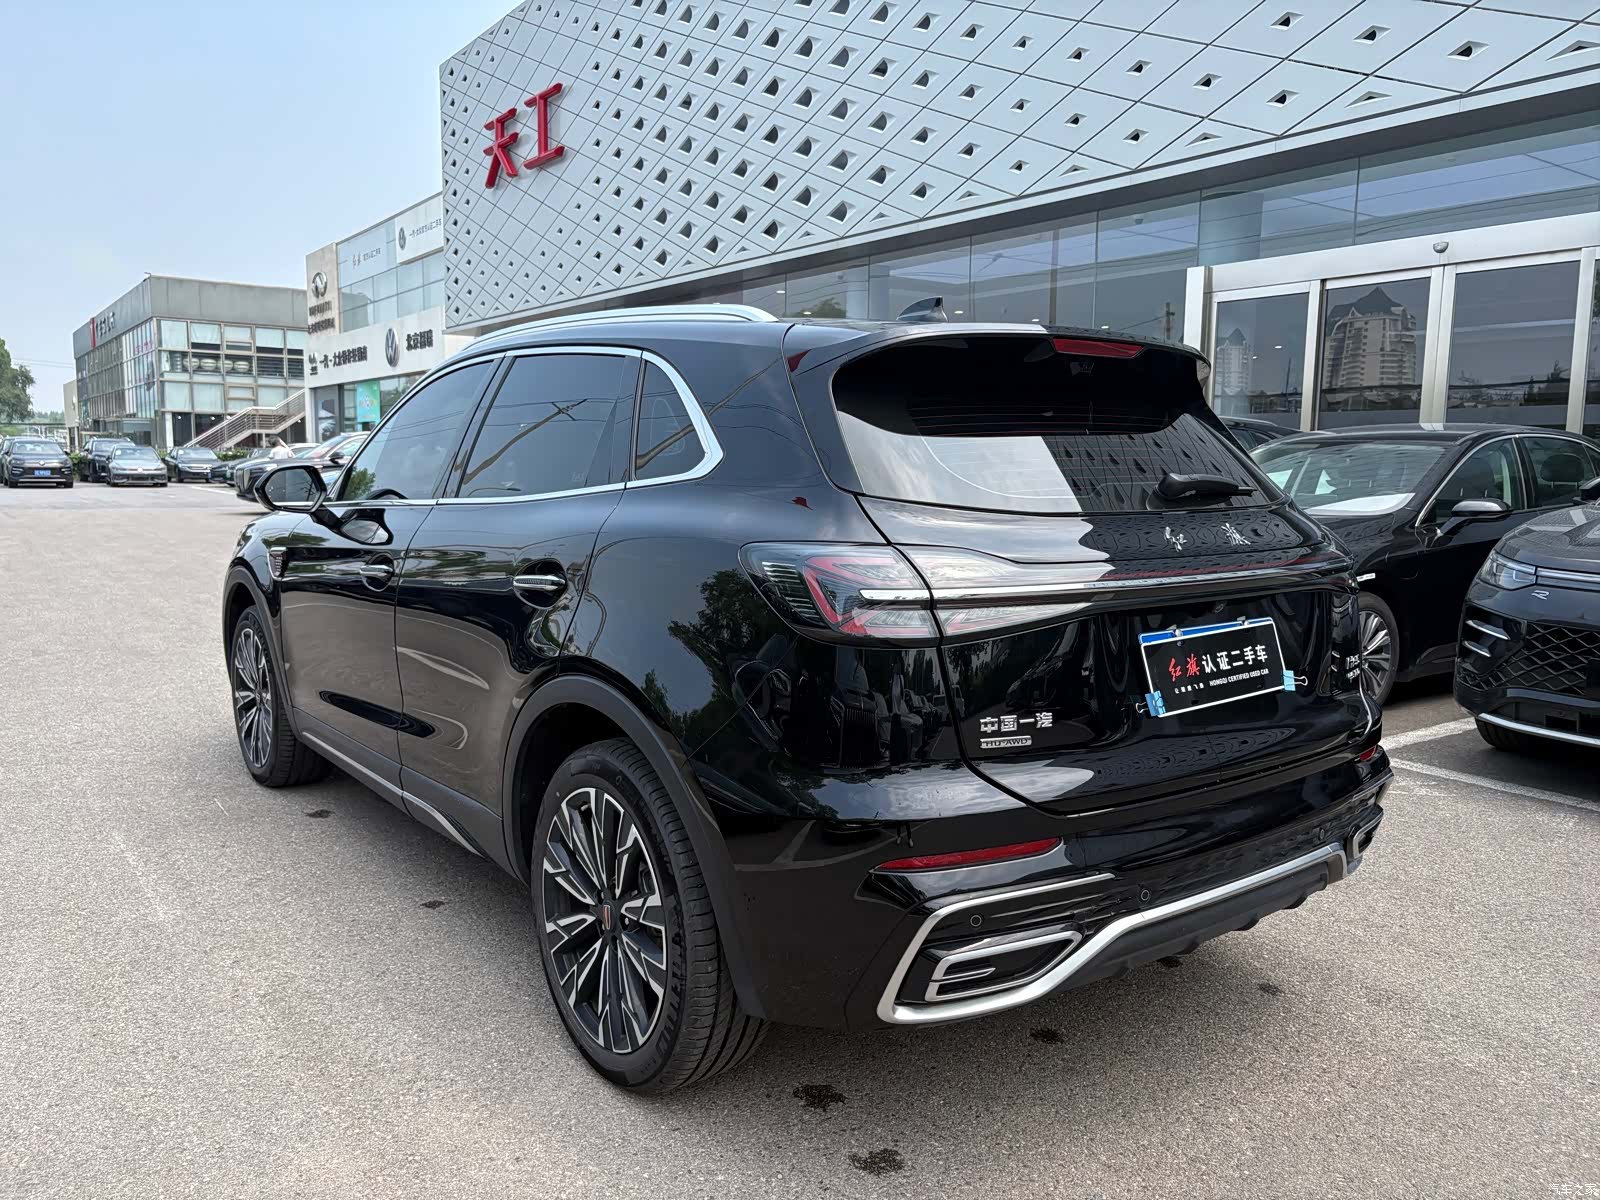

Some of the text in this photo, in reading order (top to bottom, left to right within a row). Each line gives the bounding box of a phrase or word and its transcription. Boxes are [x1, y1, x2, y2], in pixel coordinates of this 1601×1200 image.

[1168, 644, 1269, 682] 红旗认证二手车
[1227, 672, 1250, 682] CERTIFIED
[980, 712, 1053, 733] 中国一汽
